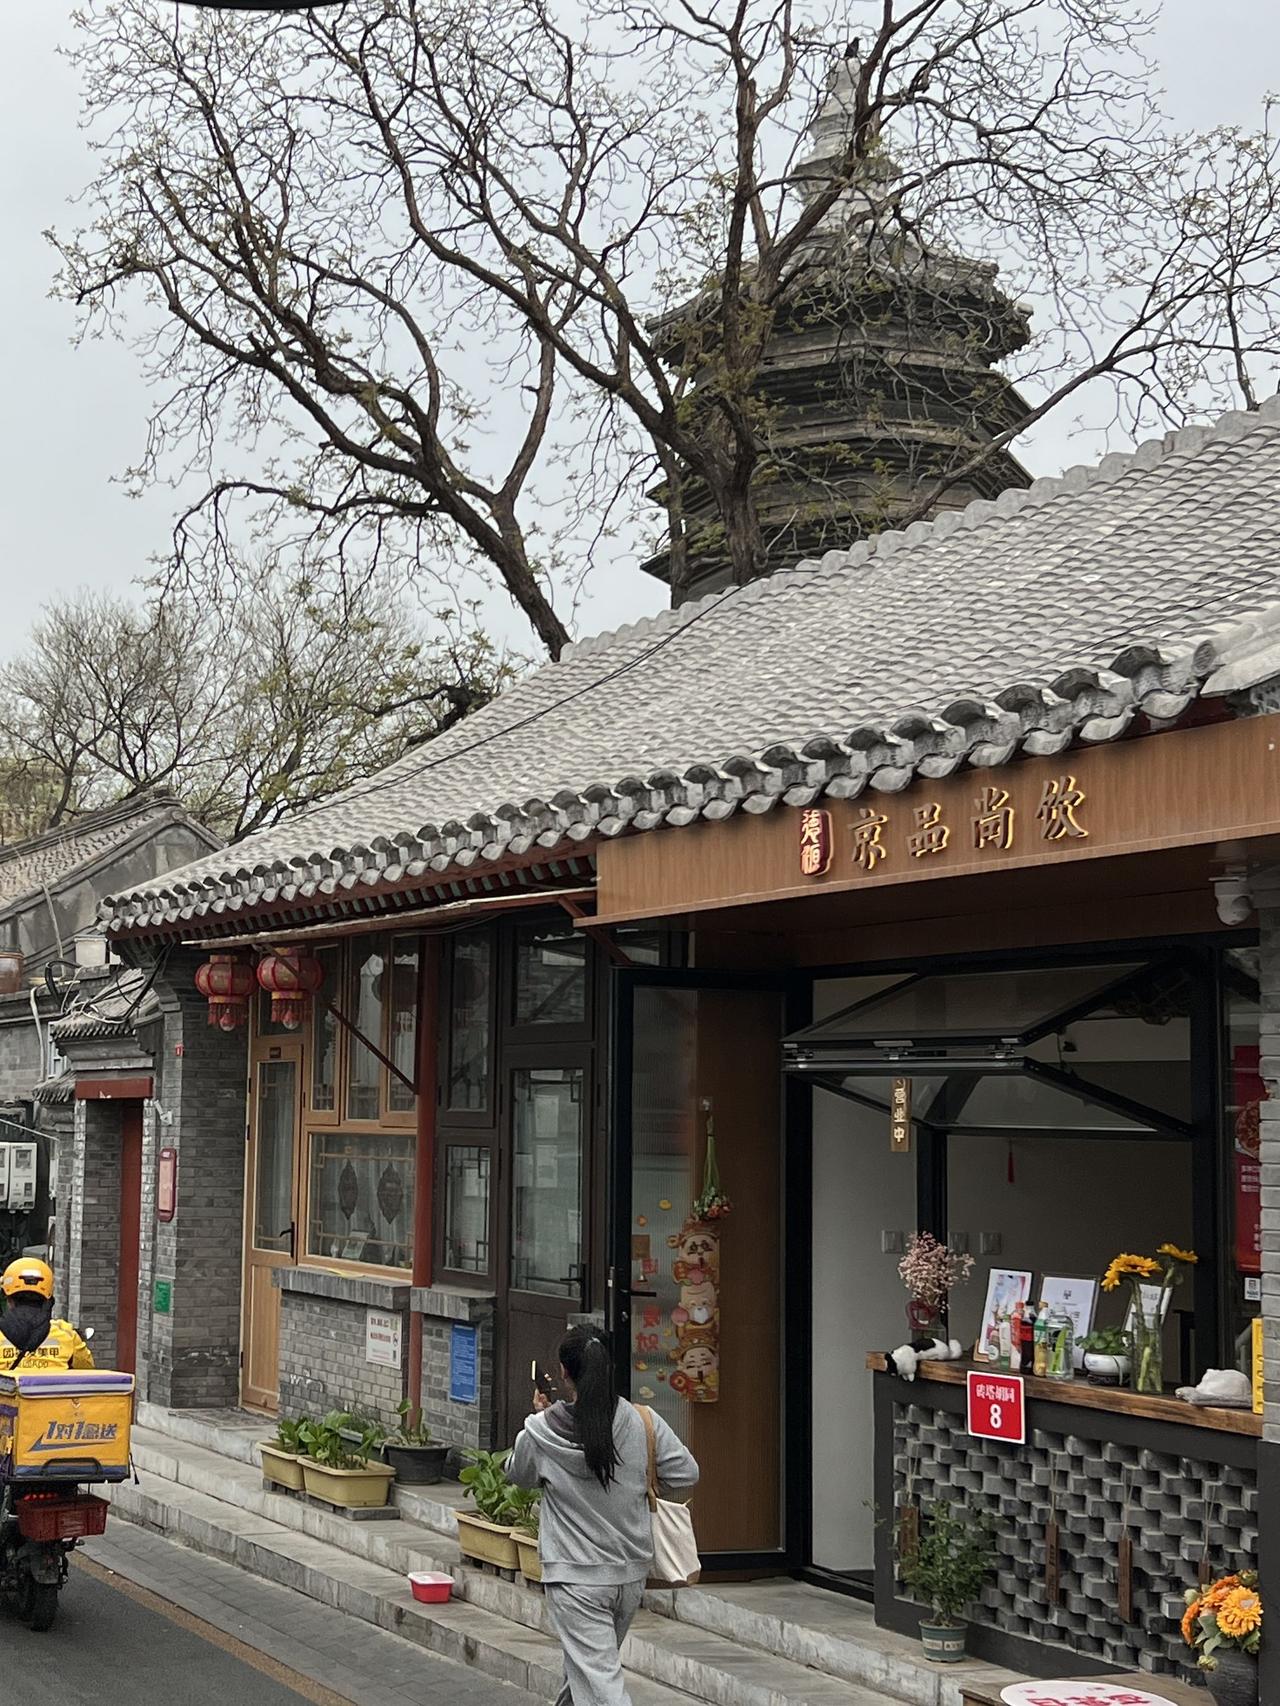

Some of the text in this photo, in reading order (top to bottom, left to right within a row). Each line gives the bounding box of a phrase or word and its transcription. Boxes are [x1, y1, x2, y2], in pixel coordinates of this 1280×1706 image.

[848, 776, 1089, 869] 京品尚饮
[893, 1088, 907, 1143] 营业中
[976, 1384, 1015, 1403] 砖塔胡同
[990, 1403, 1002, 1429] 8
